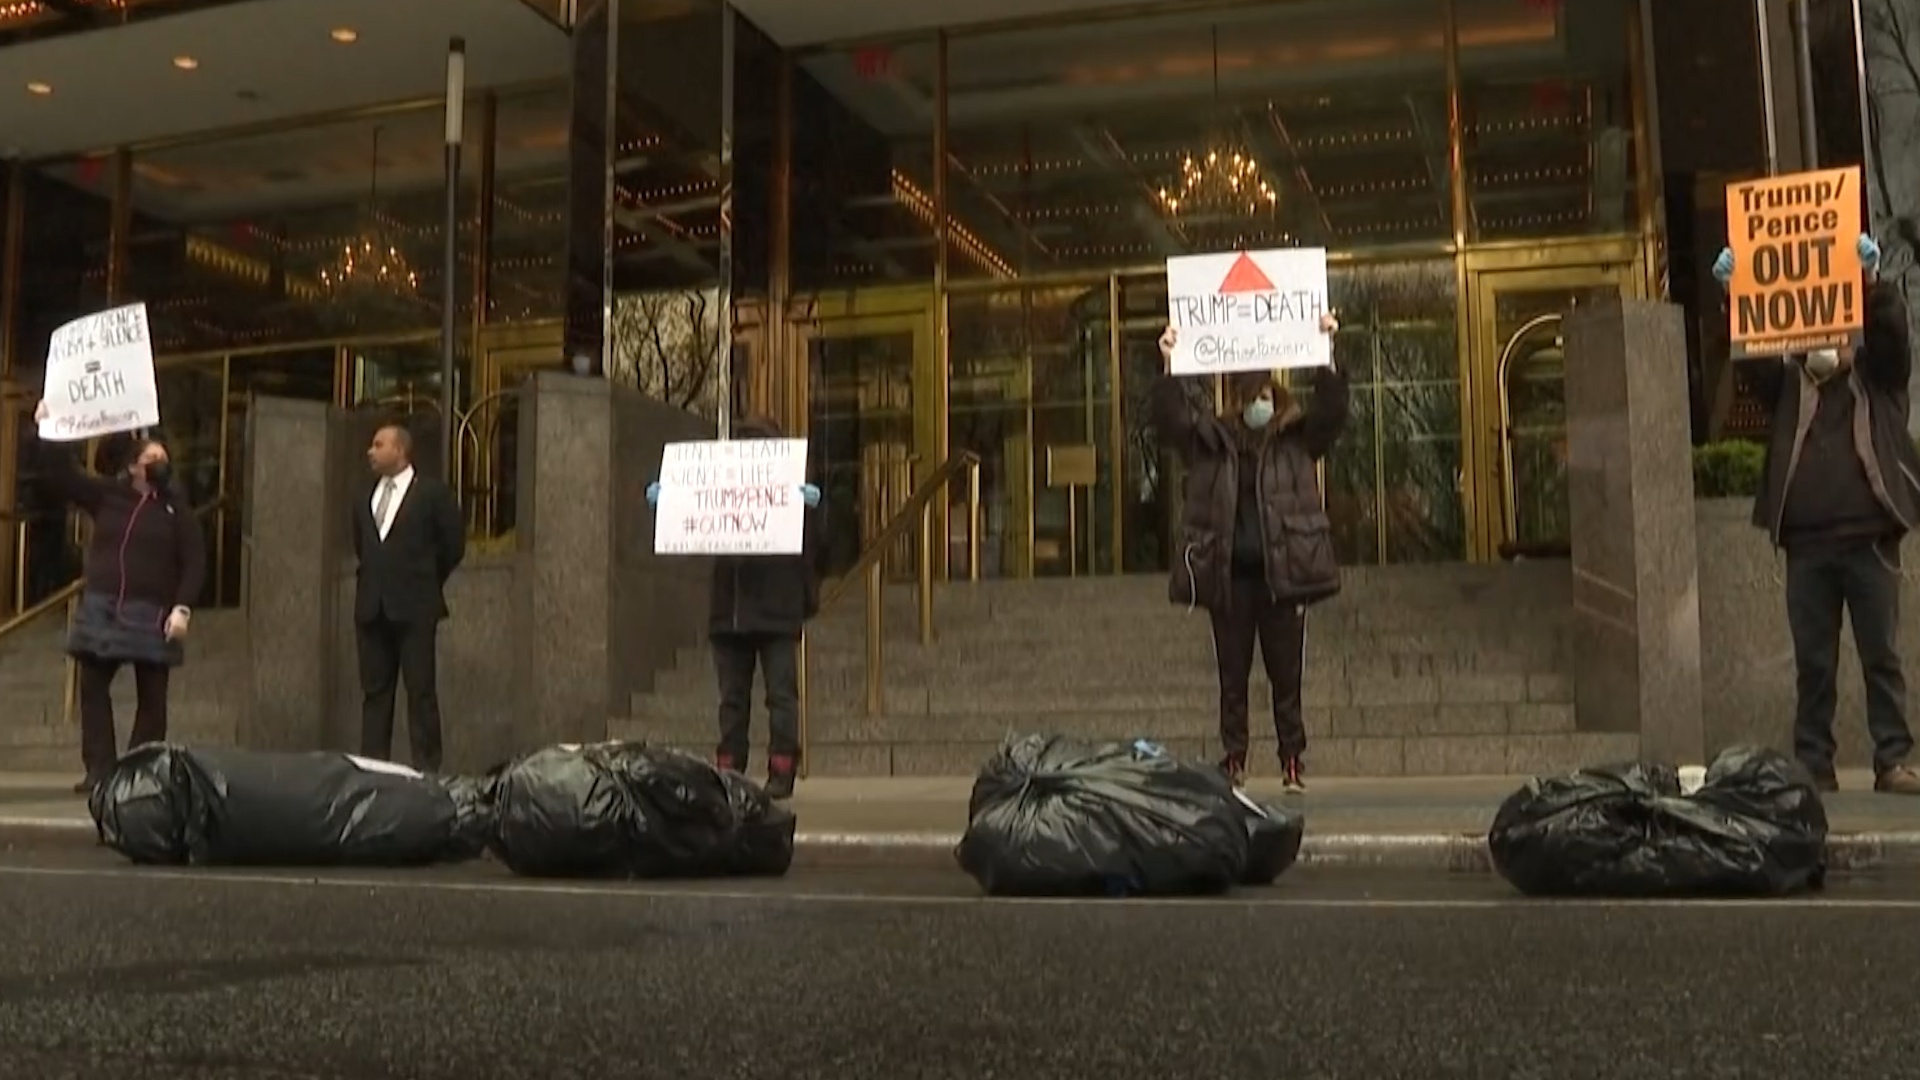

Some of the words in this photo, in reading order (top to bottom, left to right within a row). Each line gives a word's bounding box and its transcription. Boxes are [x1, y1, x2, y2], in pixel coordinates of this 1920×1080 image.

[1739, 172, 1846, 213] Trump/
[1748, 209, 1838, 241] Pence
[1753, 236, 1836, 286] OUT
[1738, 281, 1853, 335] NOW!
[68, 370, 125, 404] DEATH
[741, 463, 773, 485] LIFE
[694, 483, 788, 511] TRUMP/PENCE
[683, 511, 768, 535] #OUTNOW
